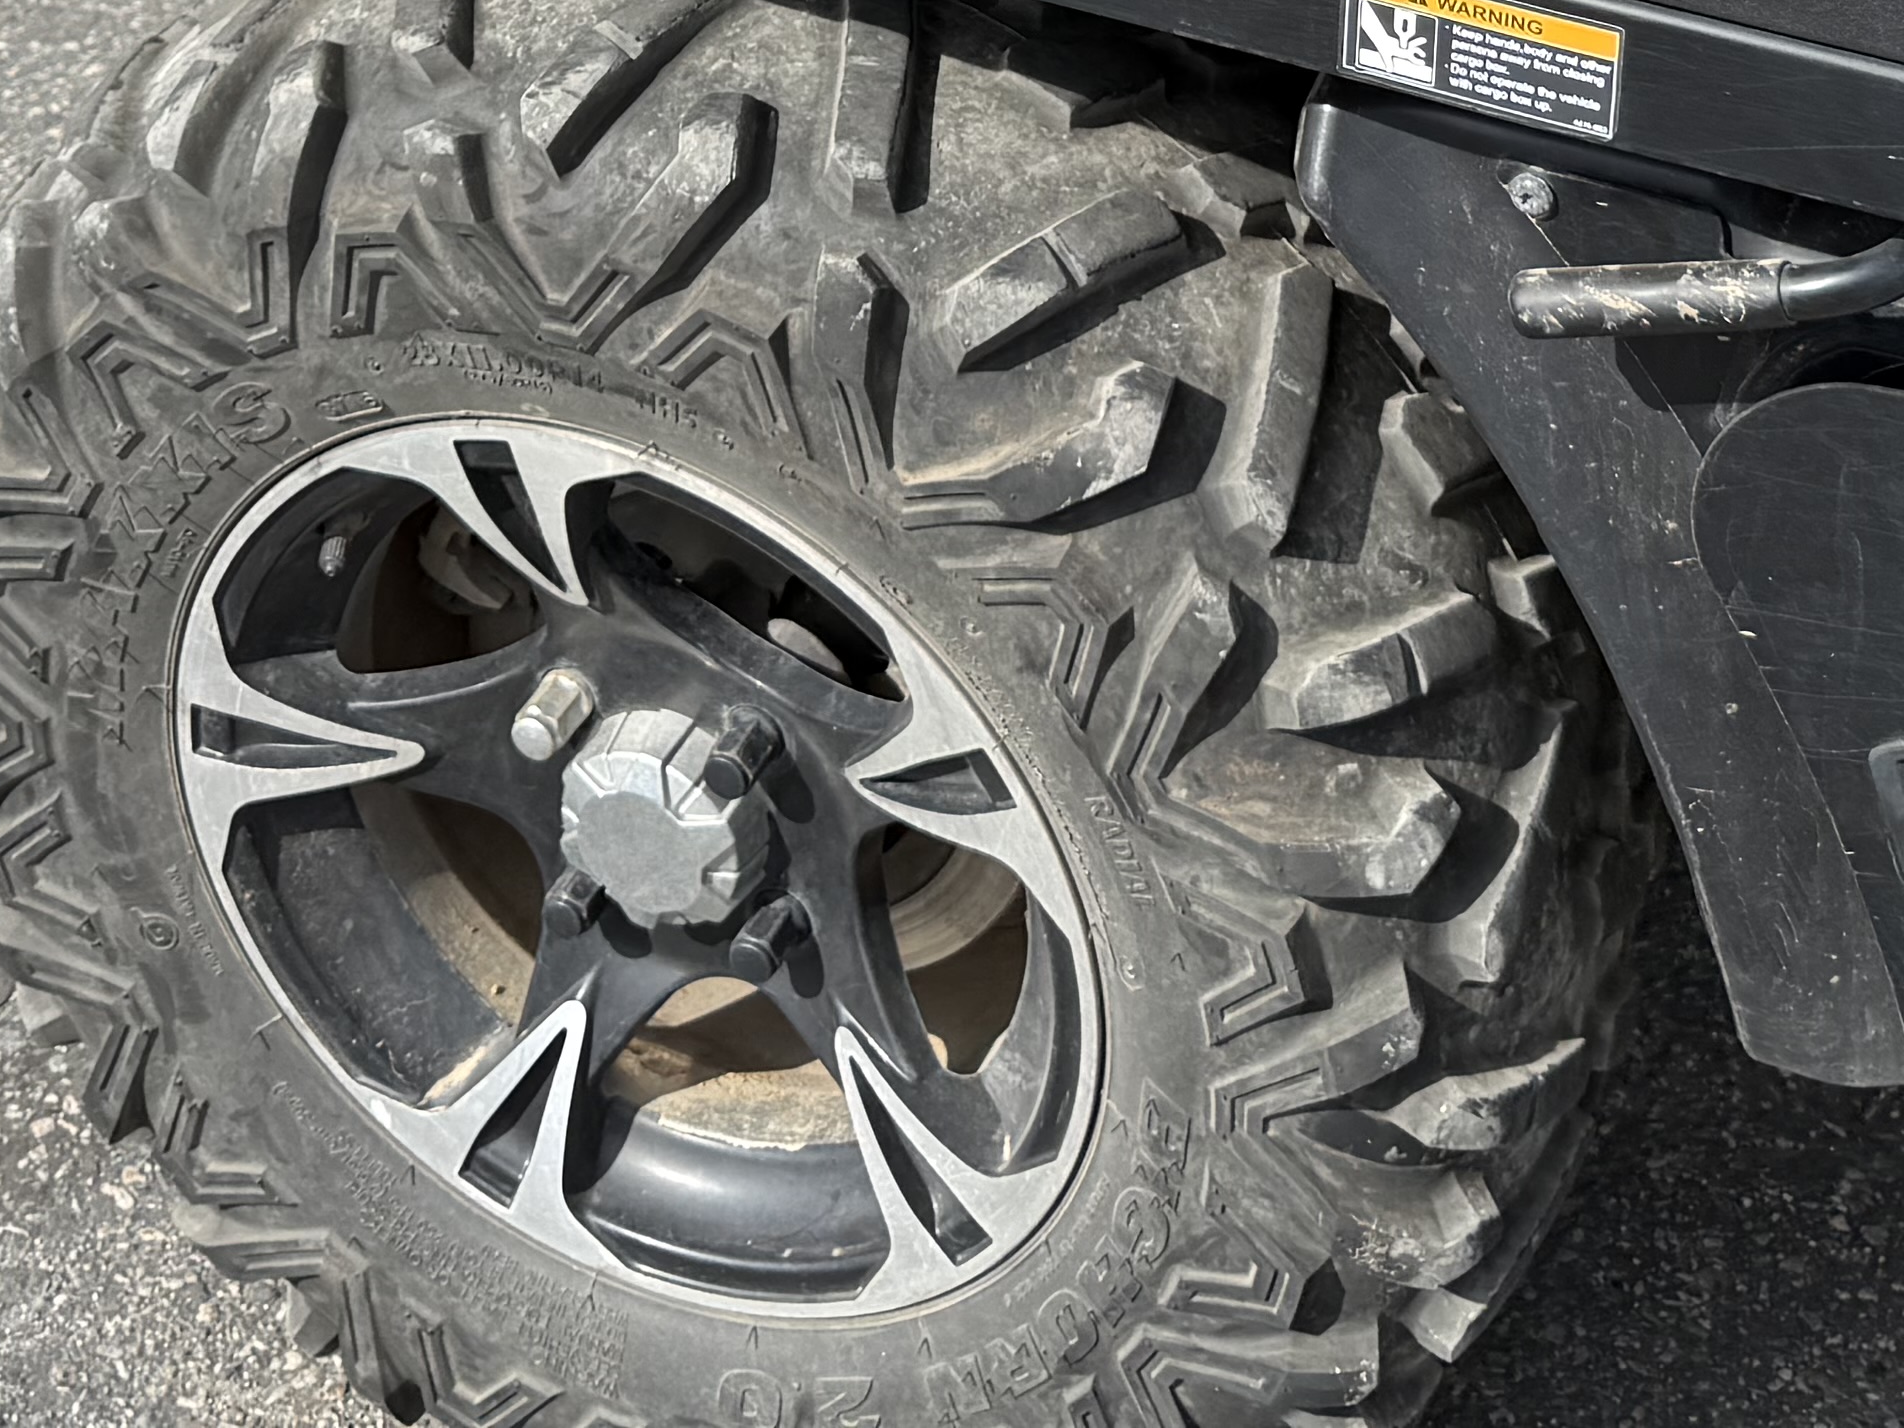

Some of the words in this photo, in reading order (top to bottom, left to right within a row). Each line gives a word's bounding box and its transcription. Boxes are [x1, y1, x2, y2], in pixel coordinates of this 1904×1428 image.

[1450, 52, 1484, 68] cargo
[1485, 59, 1511, 76] box.
[1451, 39, 1498, 59] persons
[1499, 52, 1532, 69] away
[1533, 59, 1561, 75] from
[1562, 68, 1606, 89] closing
[1452, 24, 1484, 43] Keep
[1555, 53, 1579, 67] and
[1580, 59, 1612, 75] other
[1448, 76, 1473, 91] with
[1474, 84, 1509, 101] cargo
[1509, 90, 1532, 107] box
[1534, 100, 1553, 113] up.
[1450, 62, 1468, 77] Do
[1469, 69, 1489, 83] not
[1489, 75, 1536, 95] operate
[1537, 86, 1557, 101] the
[1558, 93, 1602, 112] vehicle
[64, 380, 292, 750] MAXXIS
[1083, 795, 1155, 911] RADIAL
